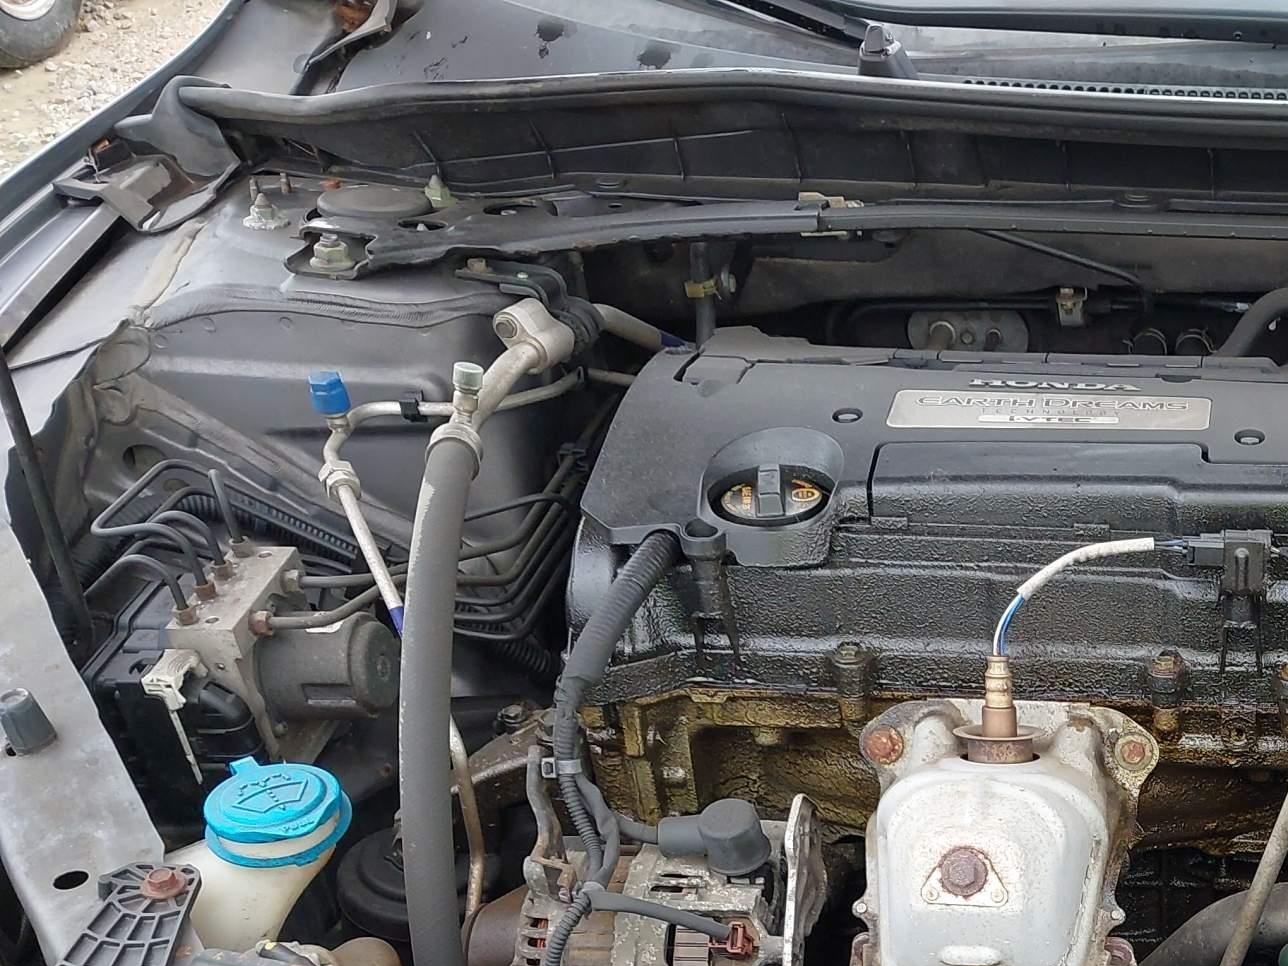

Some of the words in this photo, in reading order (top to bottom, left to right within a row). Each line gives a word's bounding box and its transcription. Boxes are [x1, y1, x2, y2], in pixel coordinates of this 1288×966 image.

[969, 378, 1141, 391] HONDA
[917, 396, 1035, 407] EARTH
[1044, 397, 1189, 411] DREAMS
[981, 408, 1121, 416] TECHNOLOGY
